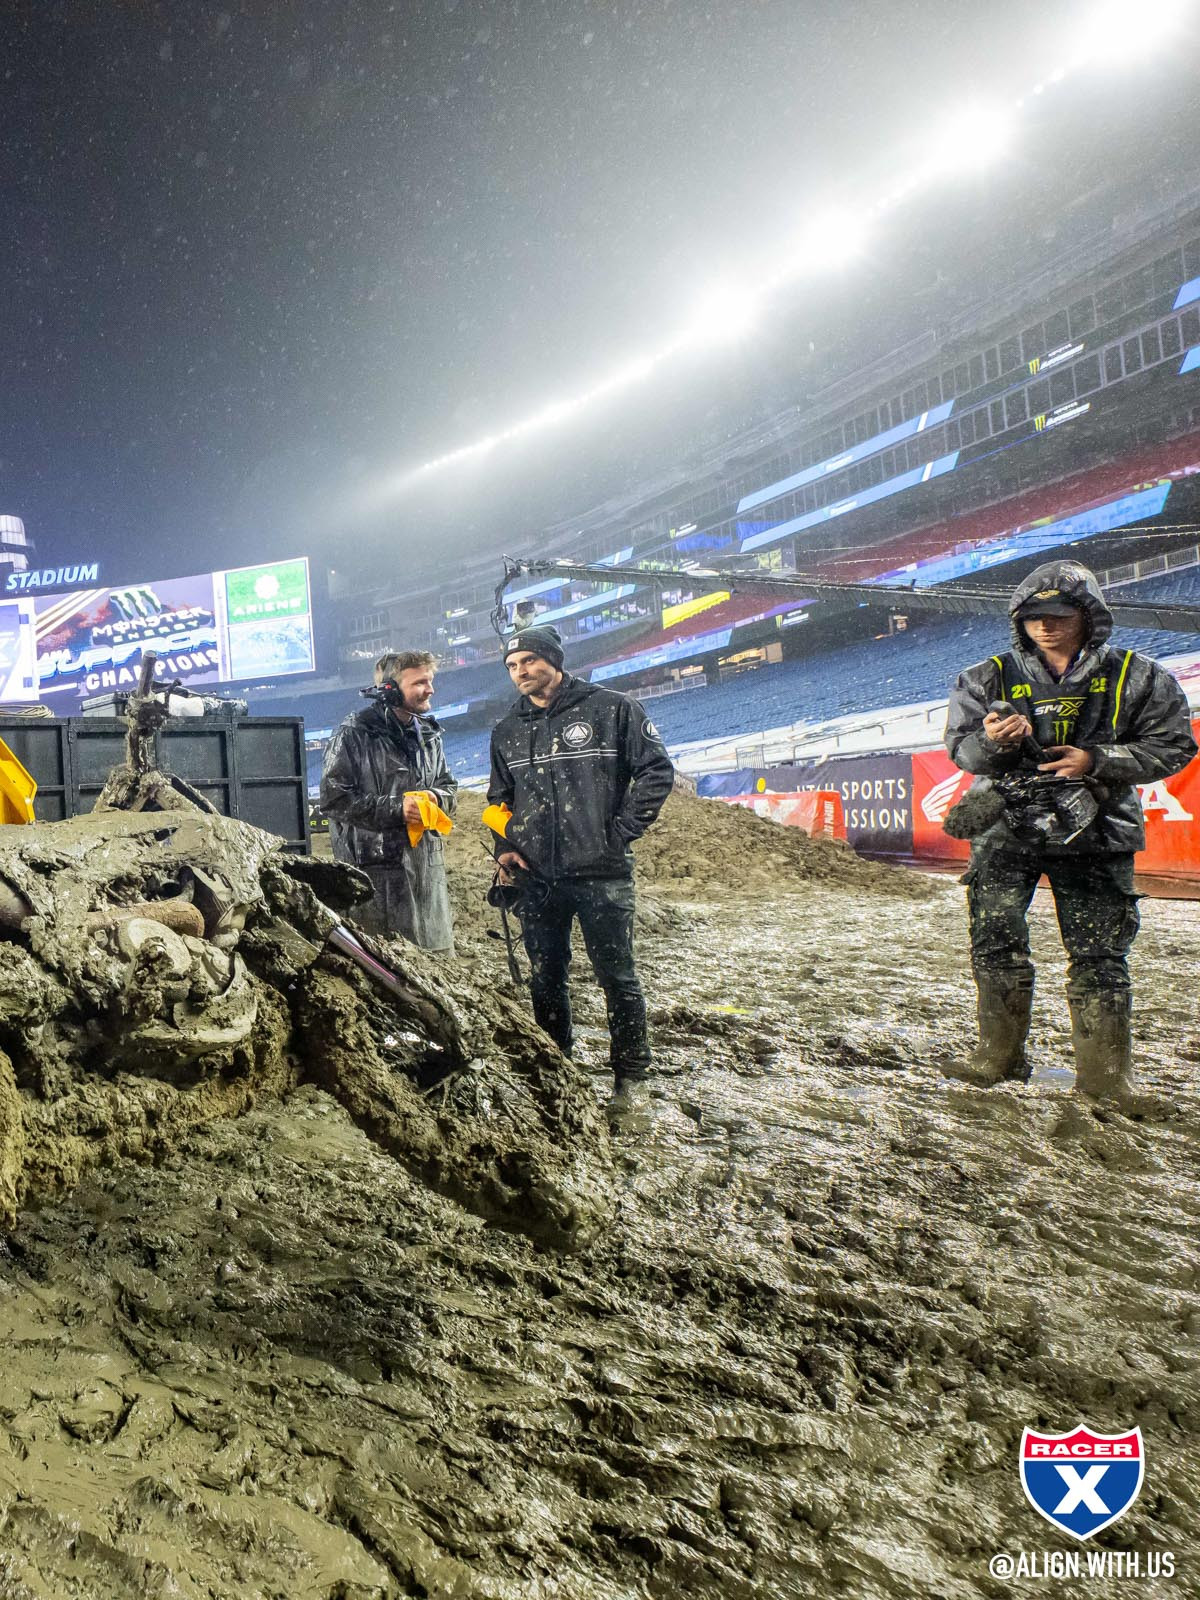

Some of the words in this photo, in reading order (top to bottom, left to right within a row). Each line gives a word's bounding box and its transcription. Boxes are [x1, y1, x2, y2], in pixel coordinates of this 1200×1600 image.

[6, 564, 98, 590] STADIUM
[1011, 683, 1032, 699] 20
[1033, 700, 1084, 717] SMX
[841, 778, 907, 801] SPORTS
[844, 808, 907, 829] ISSION
